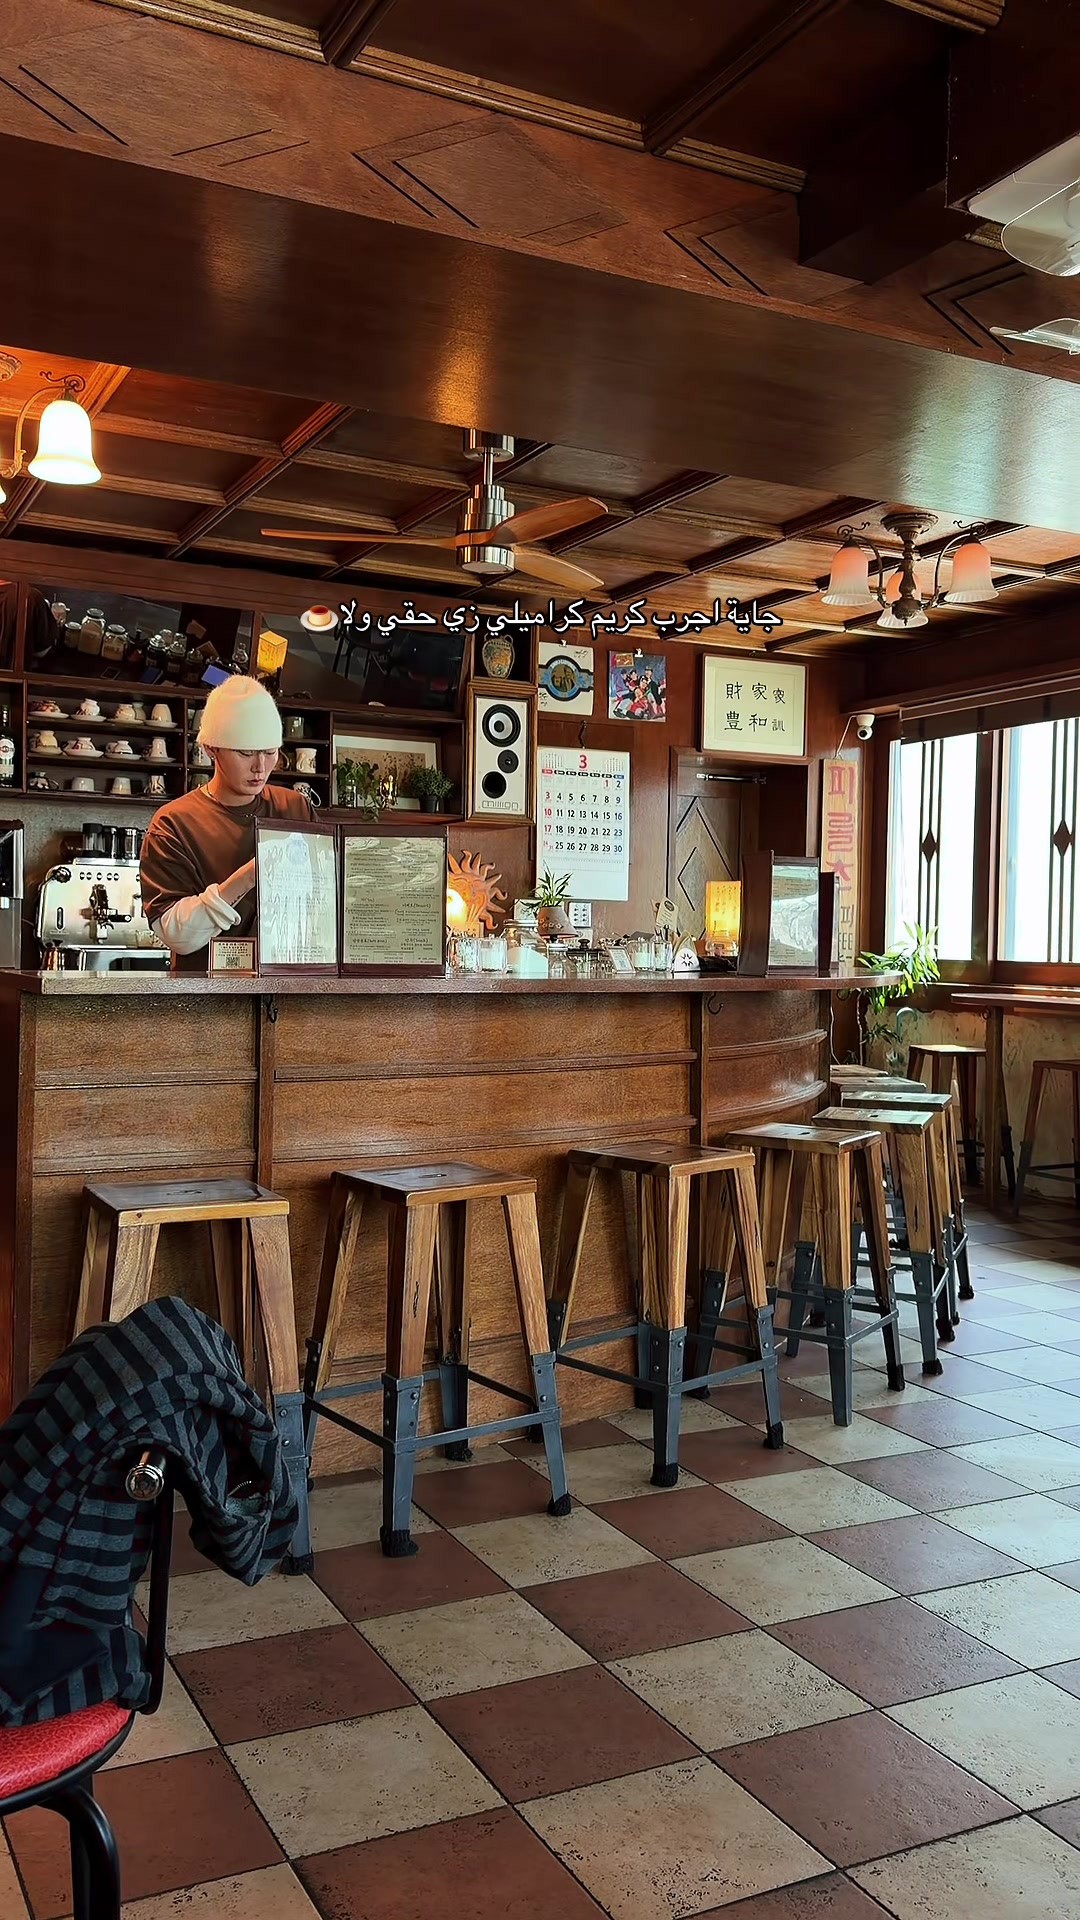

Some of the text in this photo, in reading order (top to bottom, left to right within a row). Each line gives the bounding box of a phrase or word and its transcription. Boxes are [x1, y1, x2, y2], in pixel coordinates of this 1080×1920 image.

[579, 754, 588, 769] 3
[605, 780, 609, 788] 1
[616, 780, 621, 788] 2
[546, 792, 551, 800] 3
[557, 793, 562, 801] 4
[580, 794, 586, 802] 6
[592, 795, 598, 803] 7
[604, 796, 610, 804] 8
[544, 808, 552, 816] 10
[556, 809, 563, 817] 11
[580, 810, 587, 818] 13
[603, 812, 610, 820] 15
[614, 812, 622, 820] 16
[568, 826, 575, 834] 19
[578, 827, 587, 835] 20
[602, 828, 610, 836] 22
[556, 841, 564, 850] 25
[567, 842, 575, 850] 26
[578, 843, 587, 851] 27
[590, 844, 599, 852] 28
